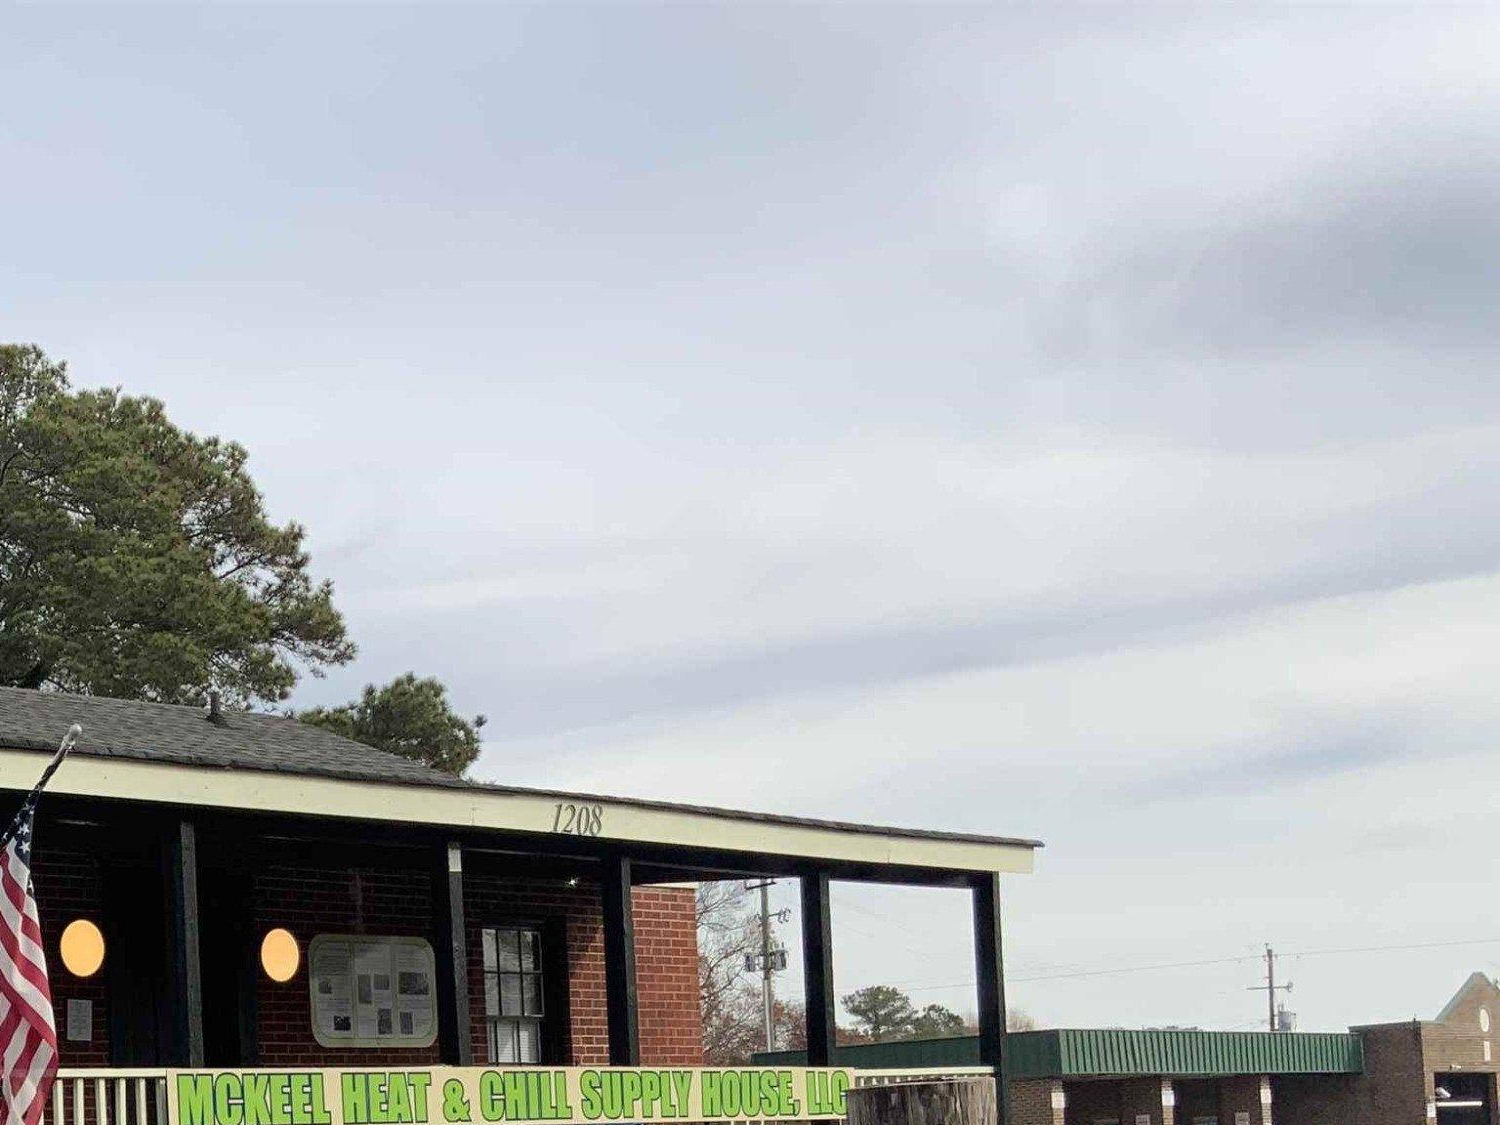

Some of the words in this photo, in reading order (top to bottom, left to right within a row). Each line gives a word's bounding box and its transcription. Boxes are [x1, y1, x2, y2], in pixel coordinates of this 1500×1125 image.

[552, 802, 603, 836] 1208
[340, 1071, 432, 1125] HEAT
[442, 1078, 472, 1123] &
[479, 1070, 573, 1122] CHILL
[580, 1070, 693, 1120] SUPPLY
[701, 1070, 800, 1117] HOUSE,
[806, 1070, 848, 1116] LLC
